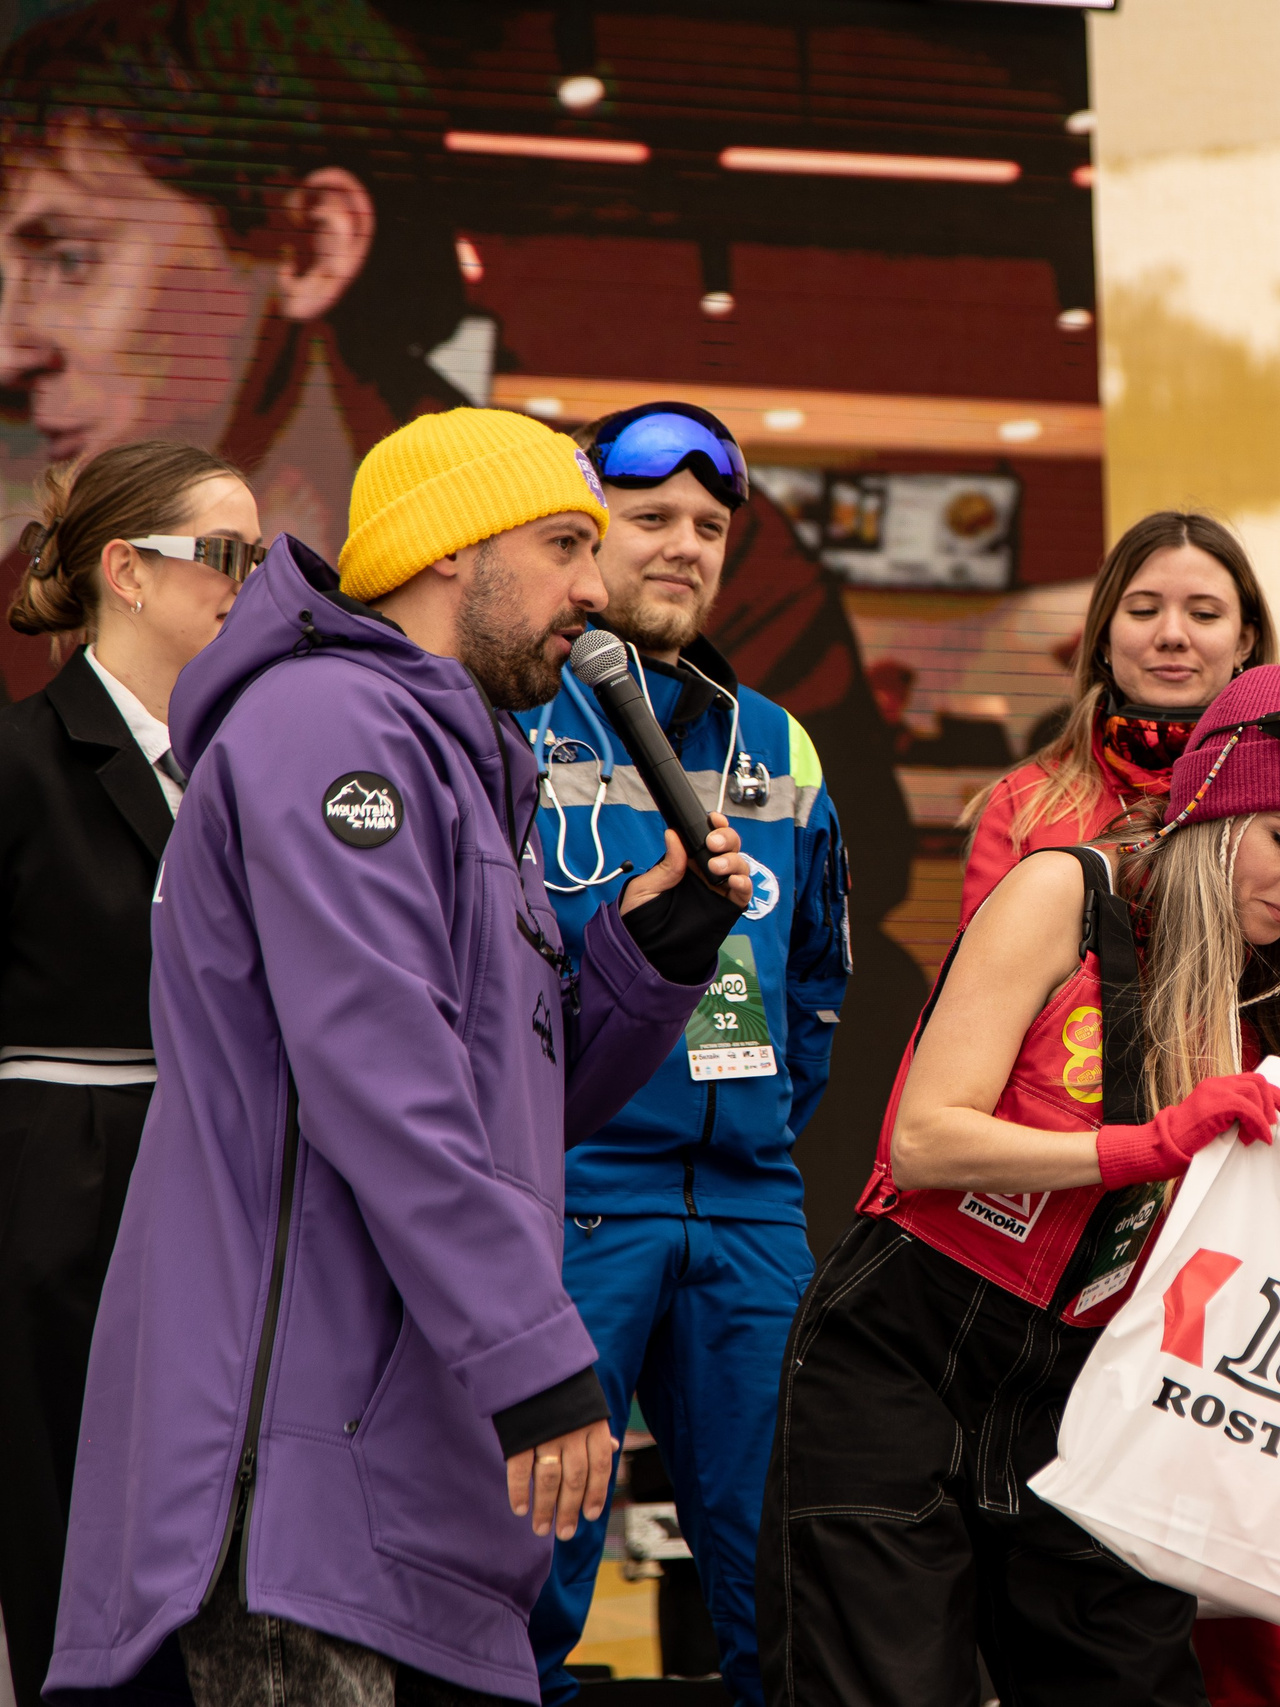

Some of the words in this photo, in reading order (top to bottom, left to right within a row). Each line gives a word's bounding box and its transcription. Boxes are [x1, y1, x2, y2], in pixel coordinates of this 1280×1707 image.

[326, 803, 395, 818] MOUNTAIN
[364, 816, 397, 830] MAN
[713, 1012, 739, 1030] 32
[964, 1199, 1027, 1237] ЛУКОЙЛ
[1114, 1202, 1155, 1233] drivee
[1112, 1239, 1131, 1260] 77
